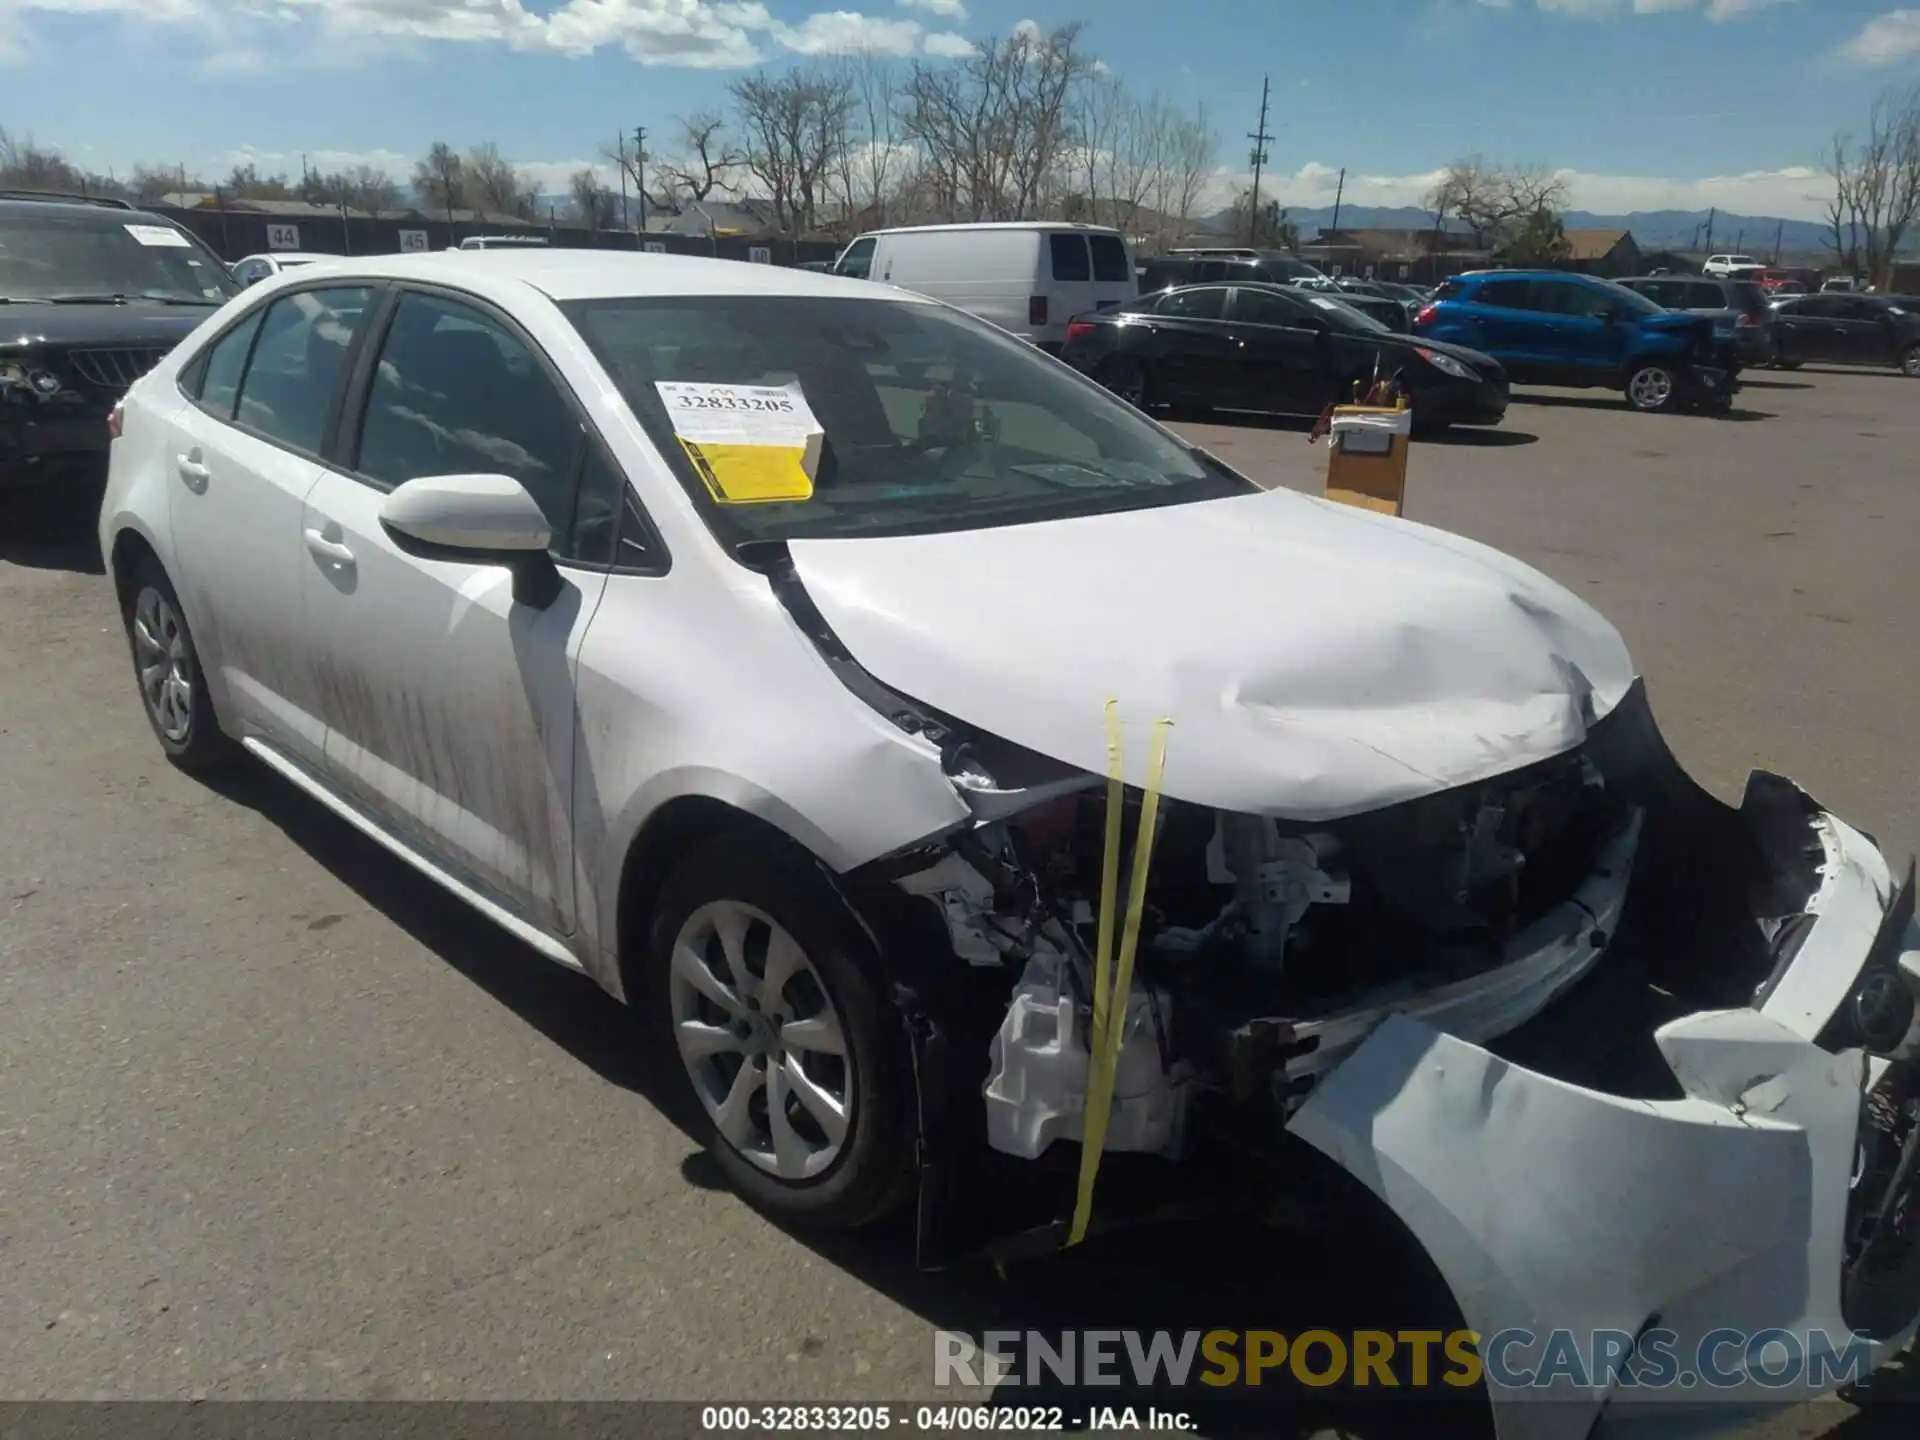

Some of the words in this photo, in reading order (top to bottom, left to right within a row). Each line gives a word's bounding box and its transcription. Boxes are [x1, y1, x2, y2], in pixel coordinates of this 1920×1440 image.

[274, 228, 294, 244] 44
[405, 234, 424, 249] 45
[678, 395, 793, 413] 32833205
